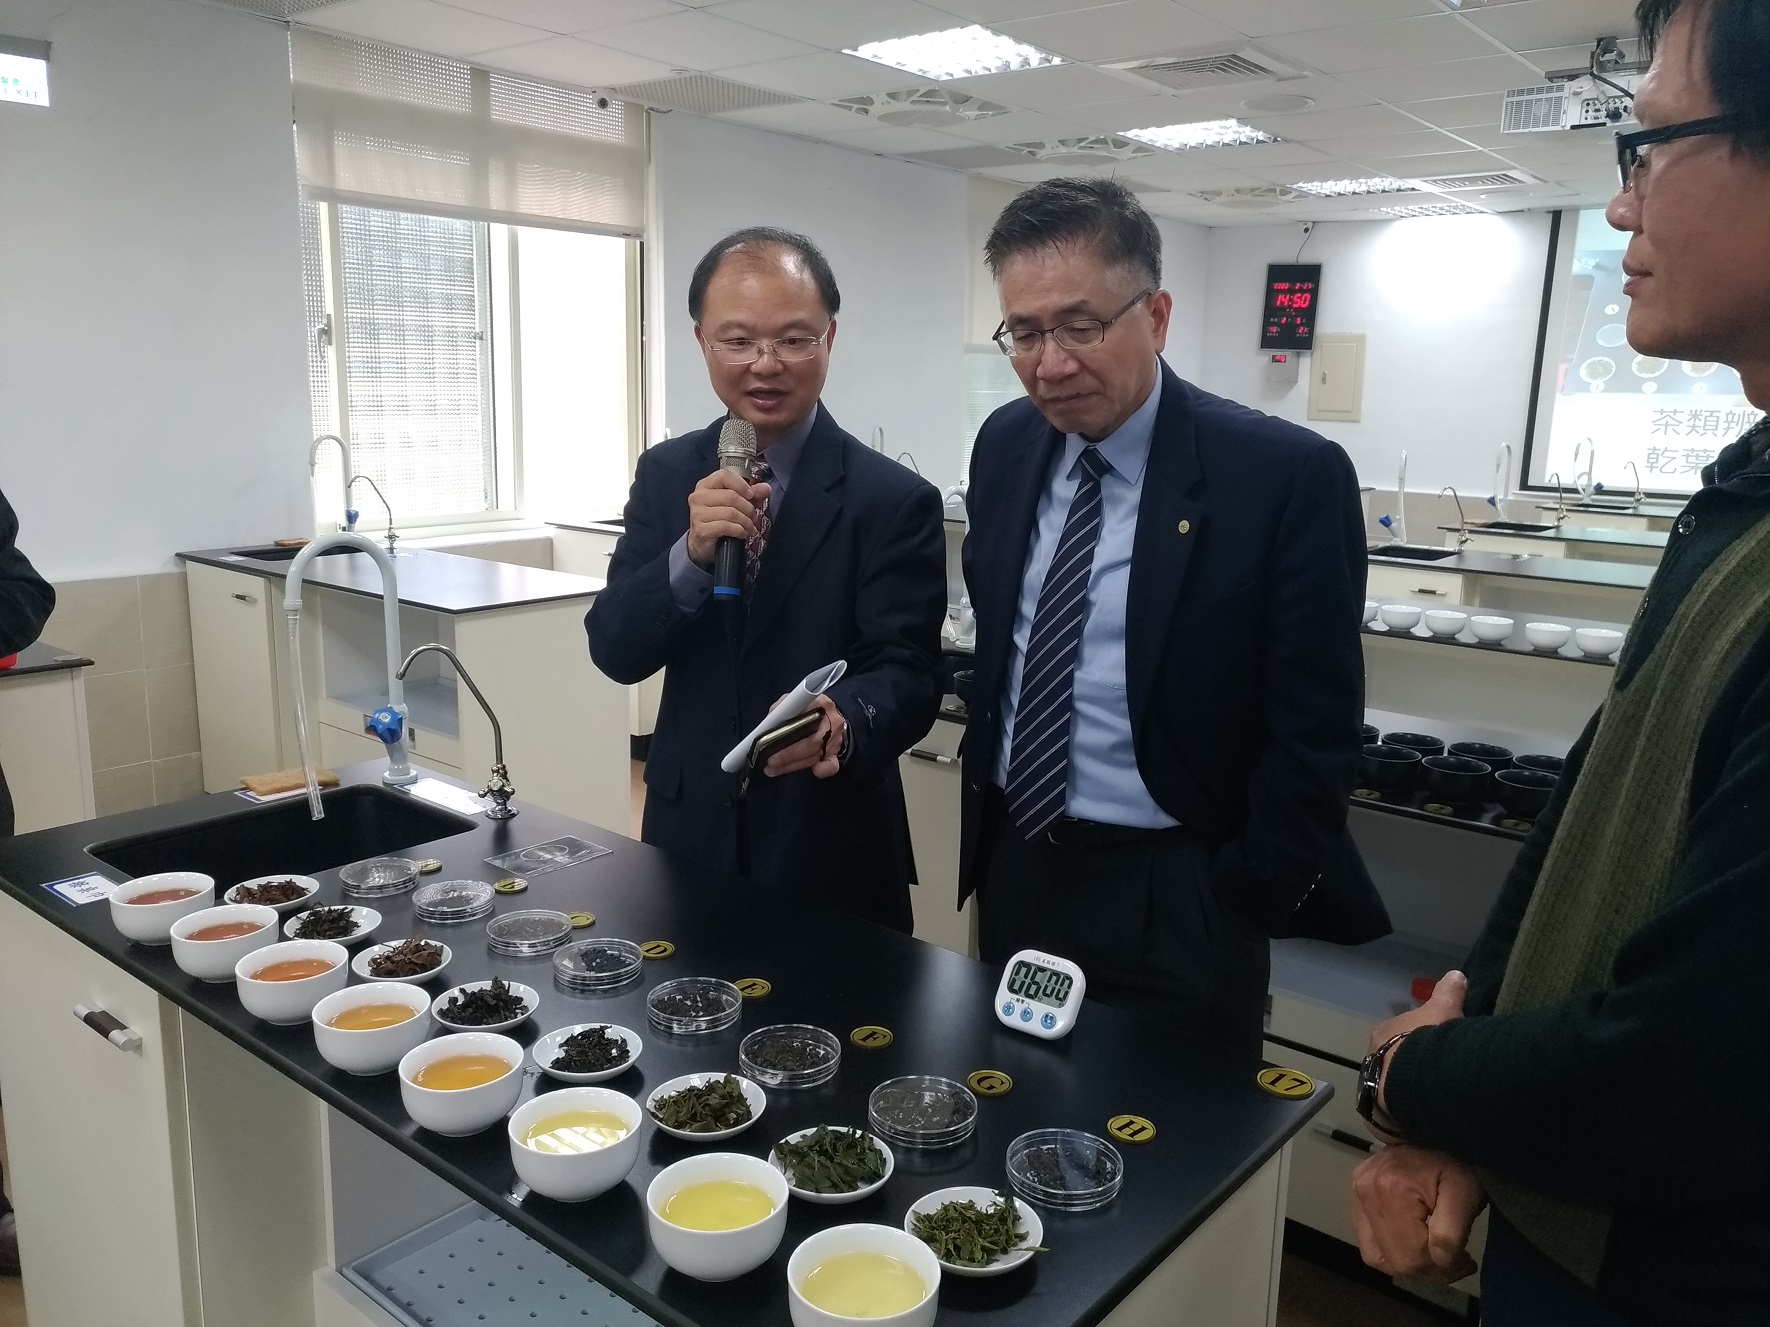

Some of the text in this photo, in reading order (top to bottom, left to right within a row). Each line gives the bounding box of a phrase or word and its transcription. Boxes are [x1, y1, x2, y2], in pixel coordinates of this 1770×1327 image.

[1276, 293, 1311, 308] 14:50
[645, 944, 668, 956] D
[739, 981, 766, 995] E
[859, 1031, 886, 1042] F
[977, 1076, 1006, 1091] G
[1266, 1073, 1307, 1091] 17
[1114, 1119, 1149, 1139] H
